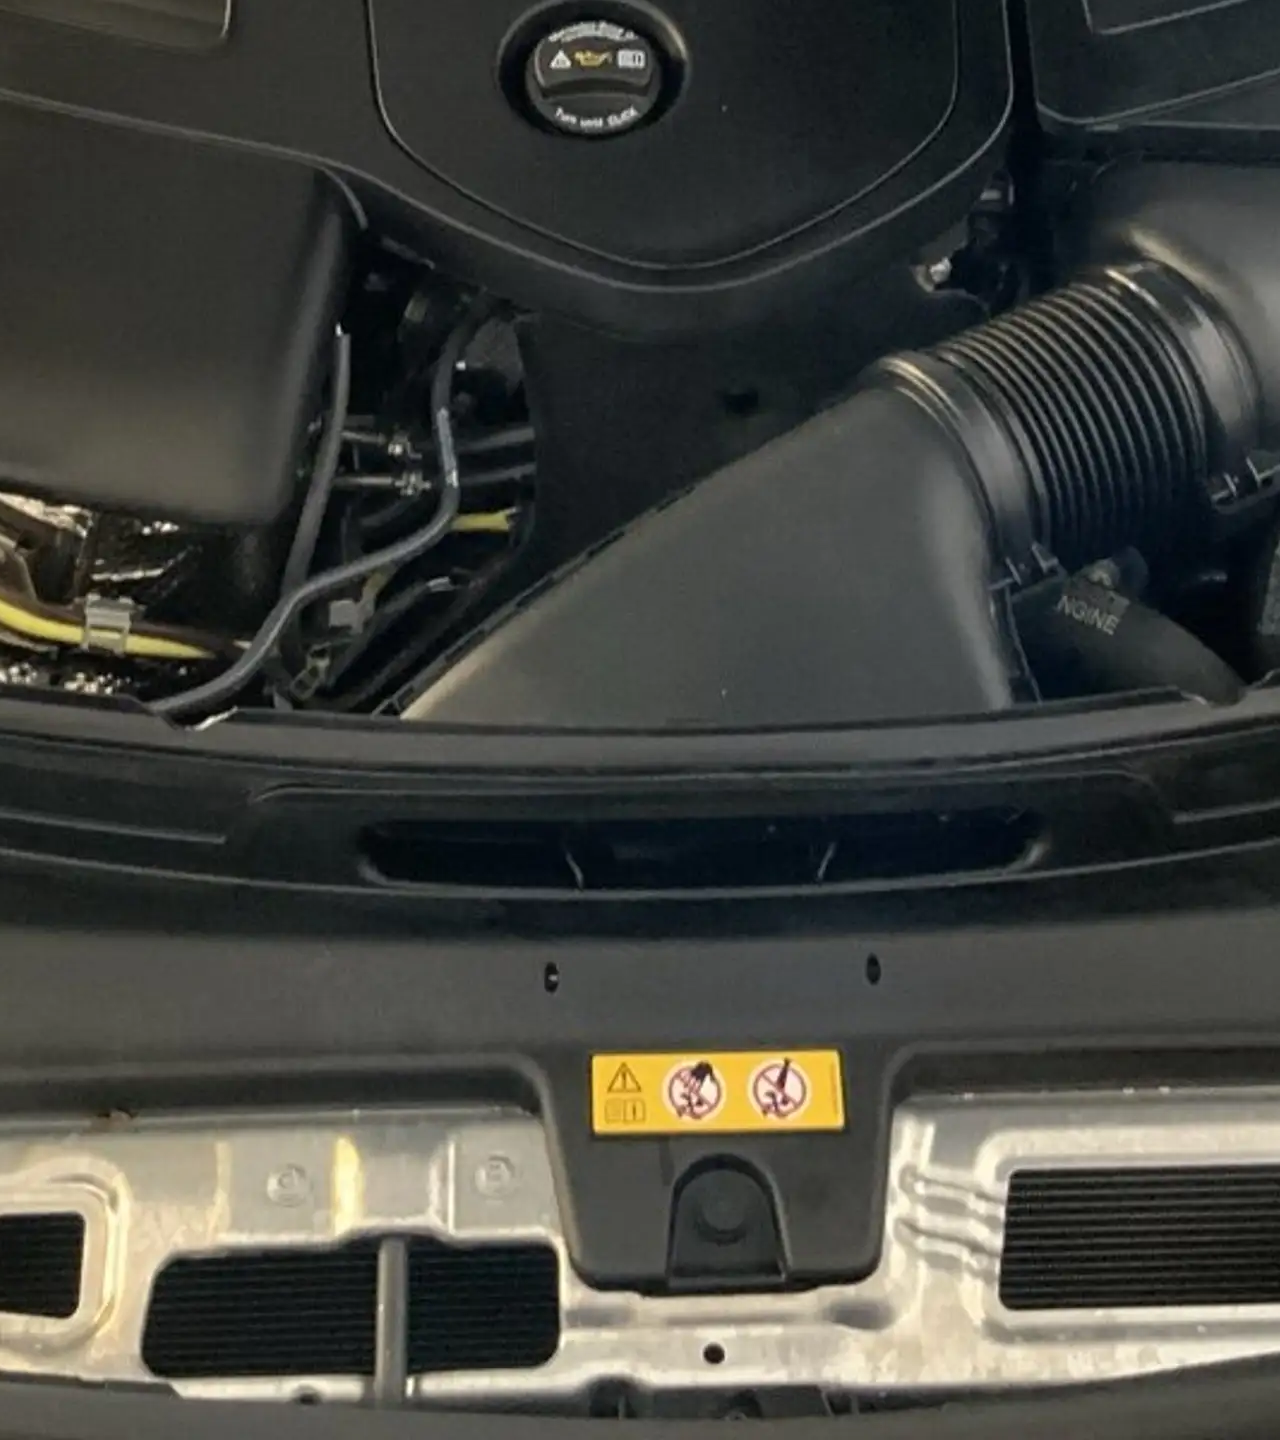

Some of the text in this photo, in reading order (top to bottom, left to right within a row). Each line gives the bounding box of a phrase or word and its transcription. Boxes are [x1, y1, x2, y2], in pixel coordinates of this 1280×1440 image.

[555, 106, 577, 125] Turn
[579, 117, 604, 128] until
[1052, 594, 1120, 636] NGINE
